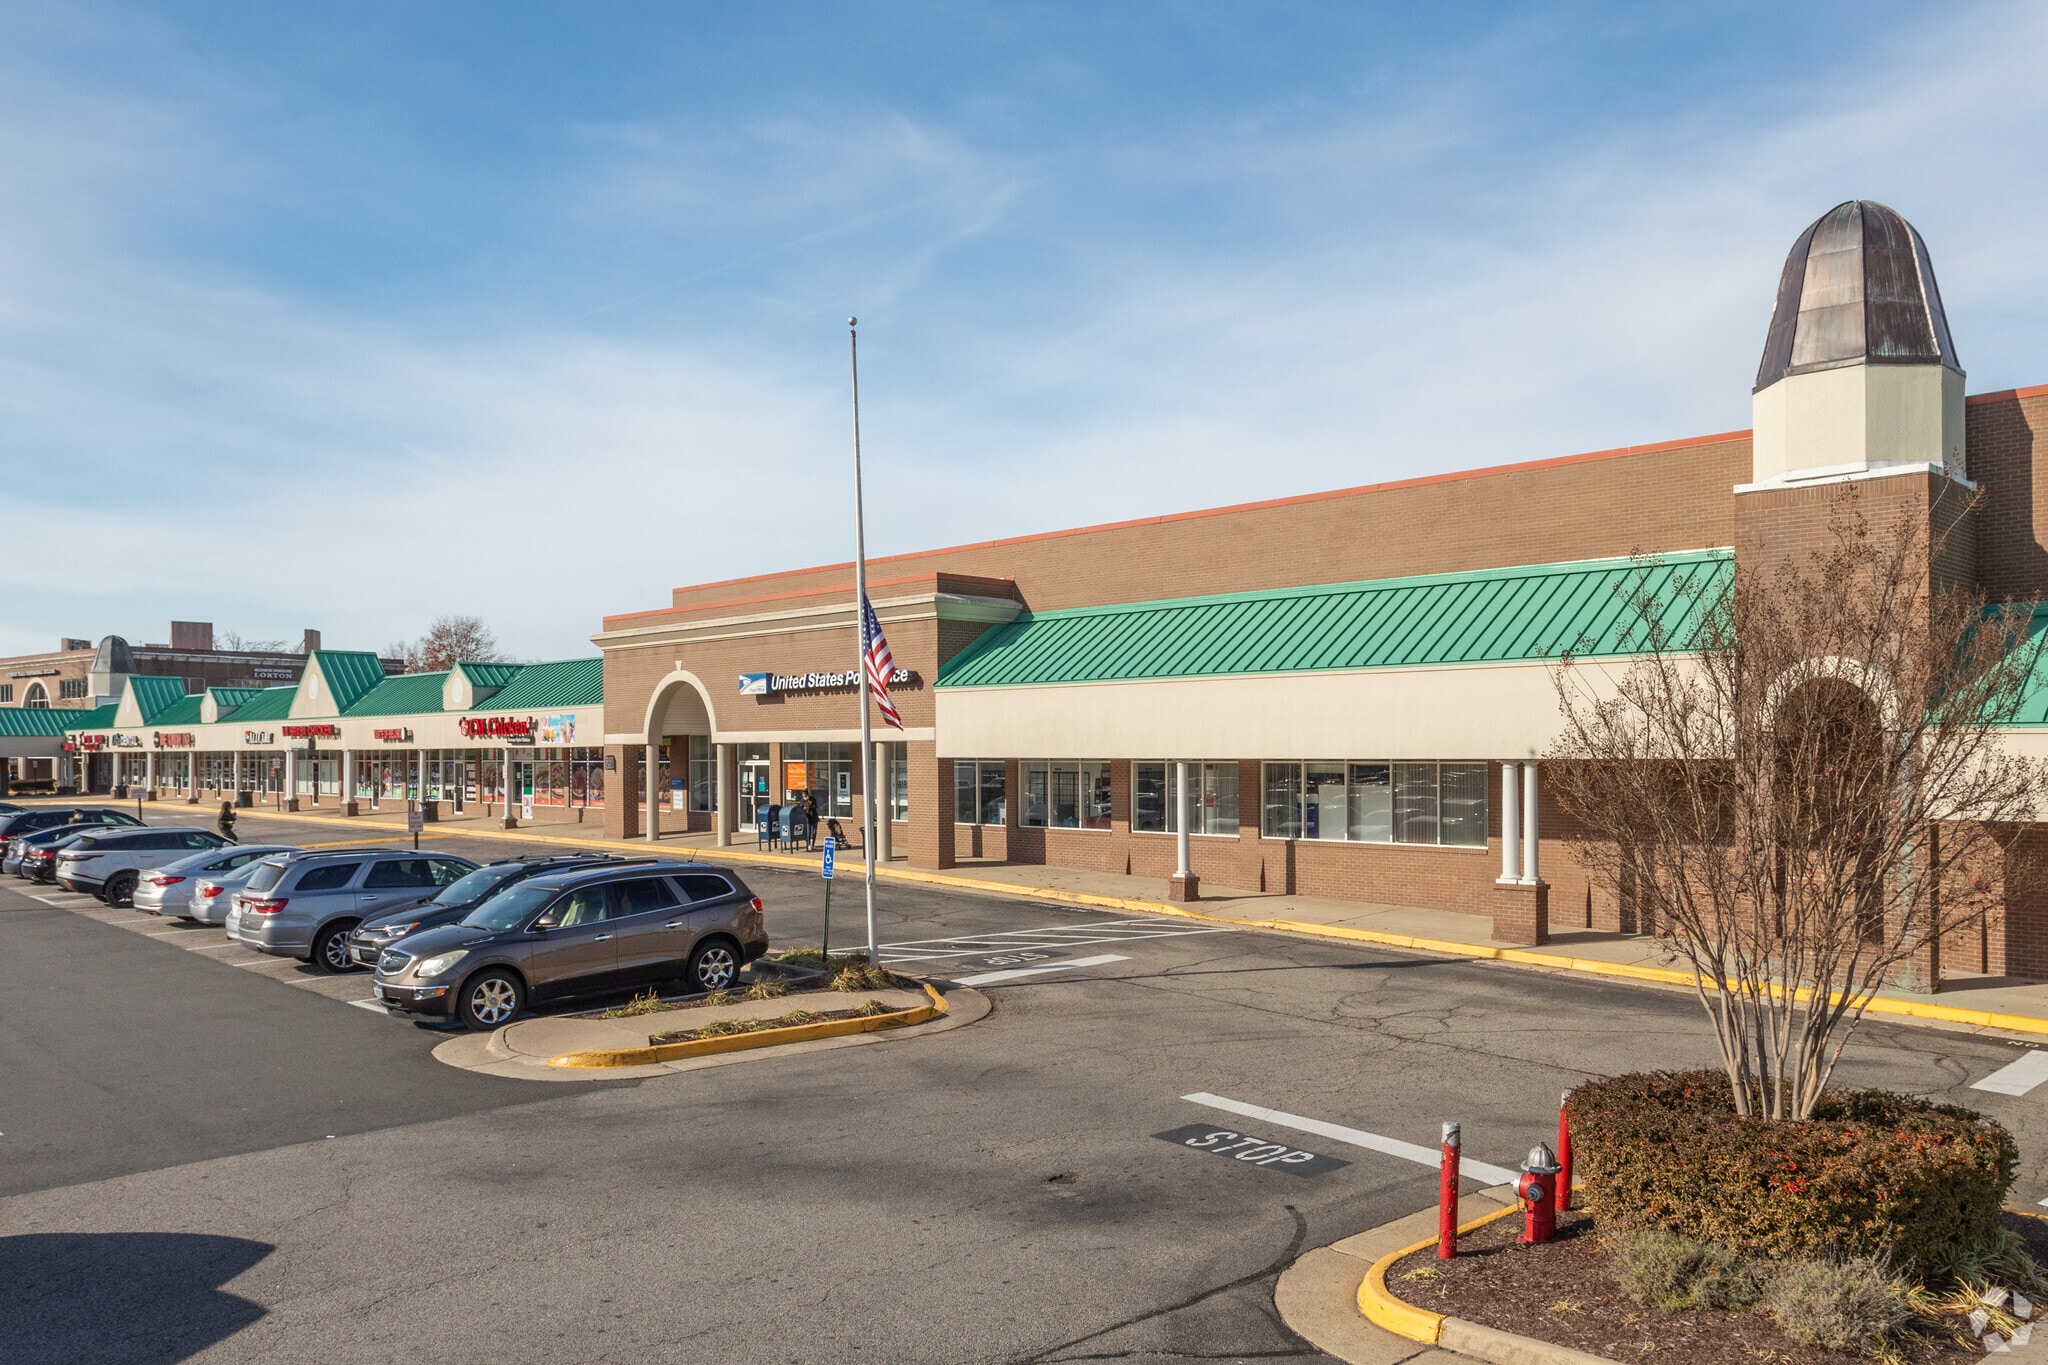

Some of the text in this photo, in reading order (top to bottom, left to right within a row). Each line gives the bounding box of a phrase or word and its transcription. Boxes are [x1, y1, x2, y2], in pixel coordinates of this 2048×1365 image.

[771, 673, 807, 690] United
[807, 672, 844, 688] States
[487, 717, 528, 735] Chicken
[1185, 1131, 1315, 1165] STOP
